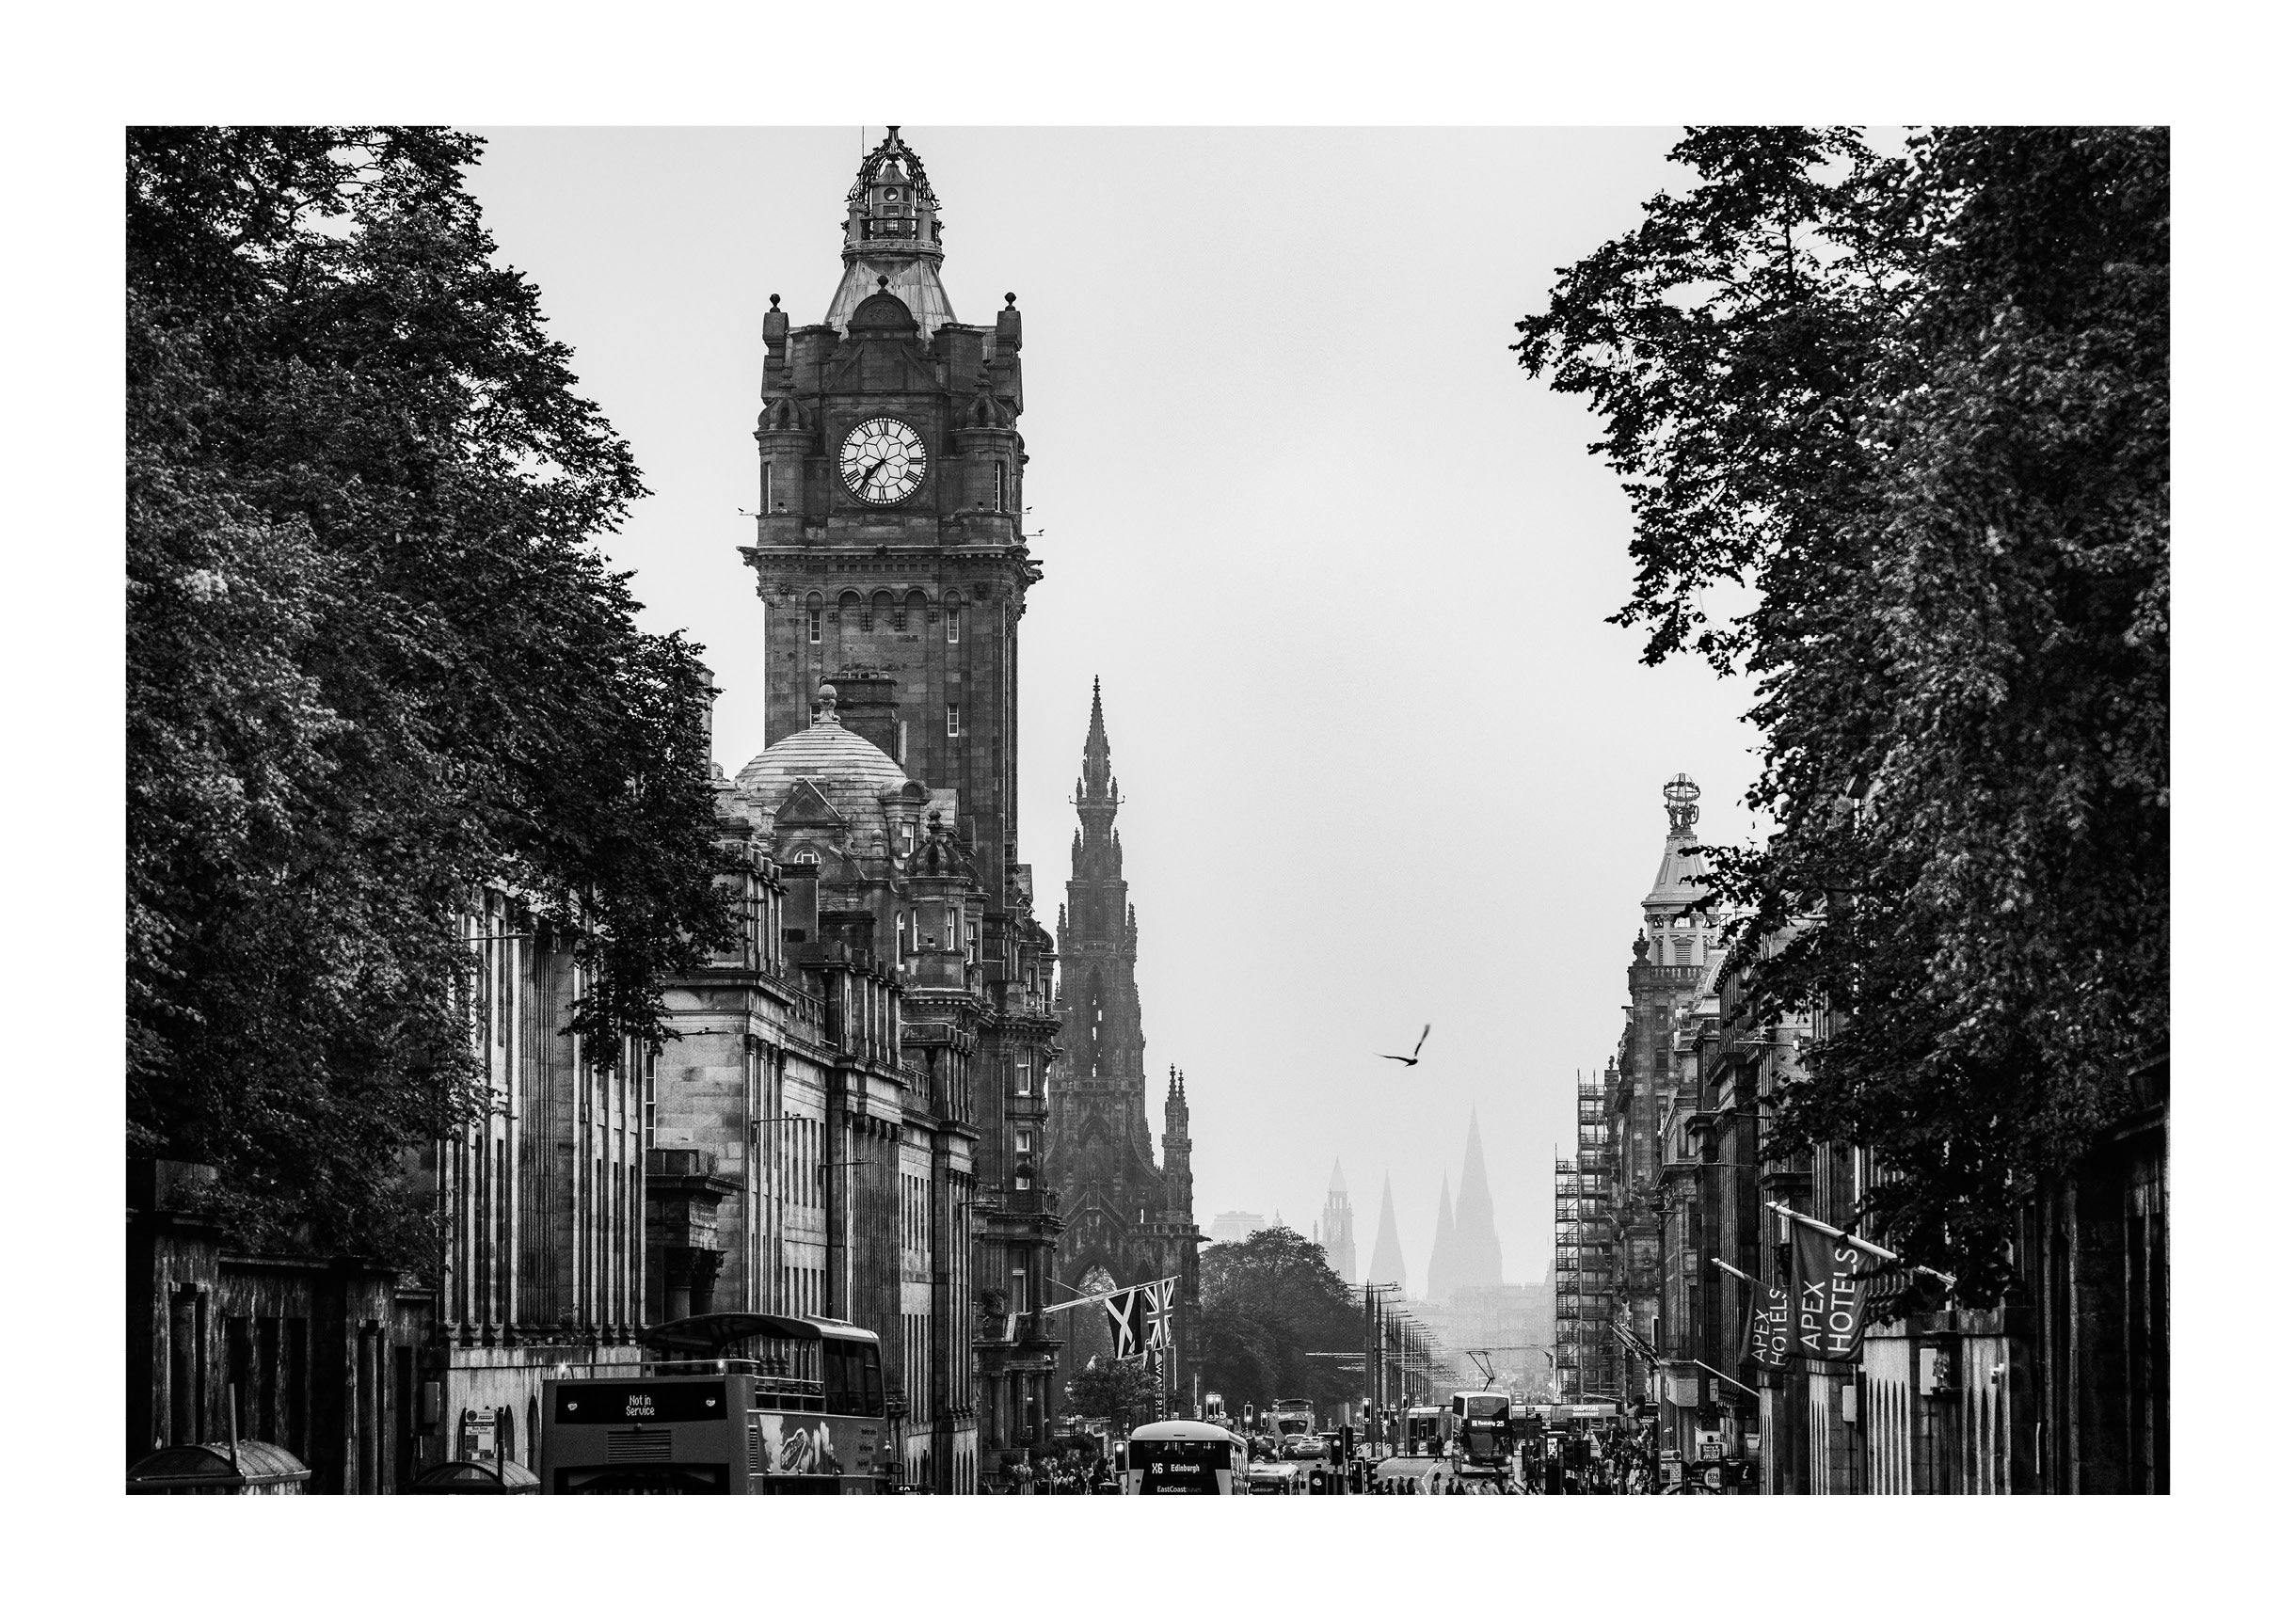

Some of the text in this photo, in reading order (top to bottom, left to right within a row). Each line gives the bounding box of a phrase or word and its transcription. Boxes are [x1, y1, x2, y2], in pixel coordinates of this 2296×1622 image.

[1799, 1280, 1826, 1351] APEX
[1827, 1248, 1858, 1352] HOTELS
[1751, 1308, 1770, 1363] APEX
[626, 1406, 655, 1416] Service
[630, 1394, 651, 1406] Not in
[1151, 1462, 1200, 1474] X6 Edinburgh
